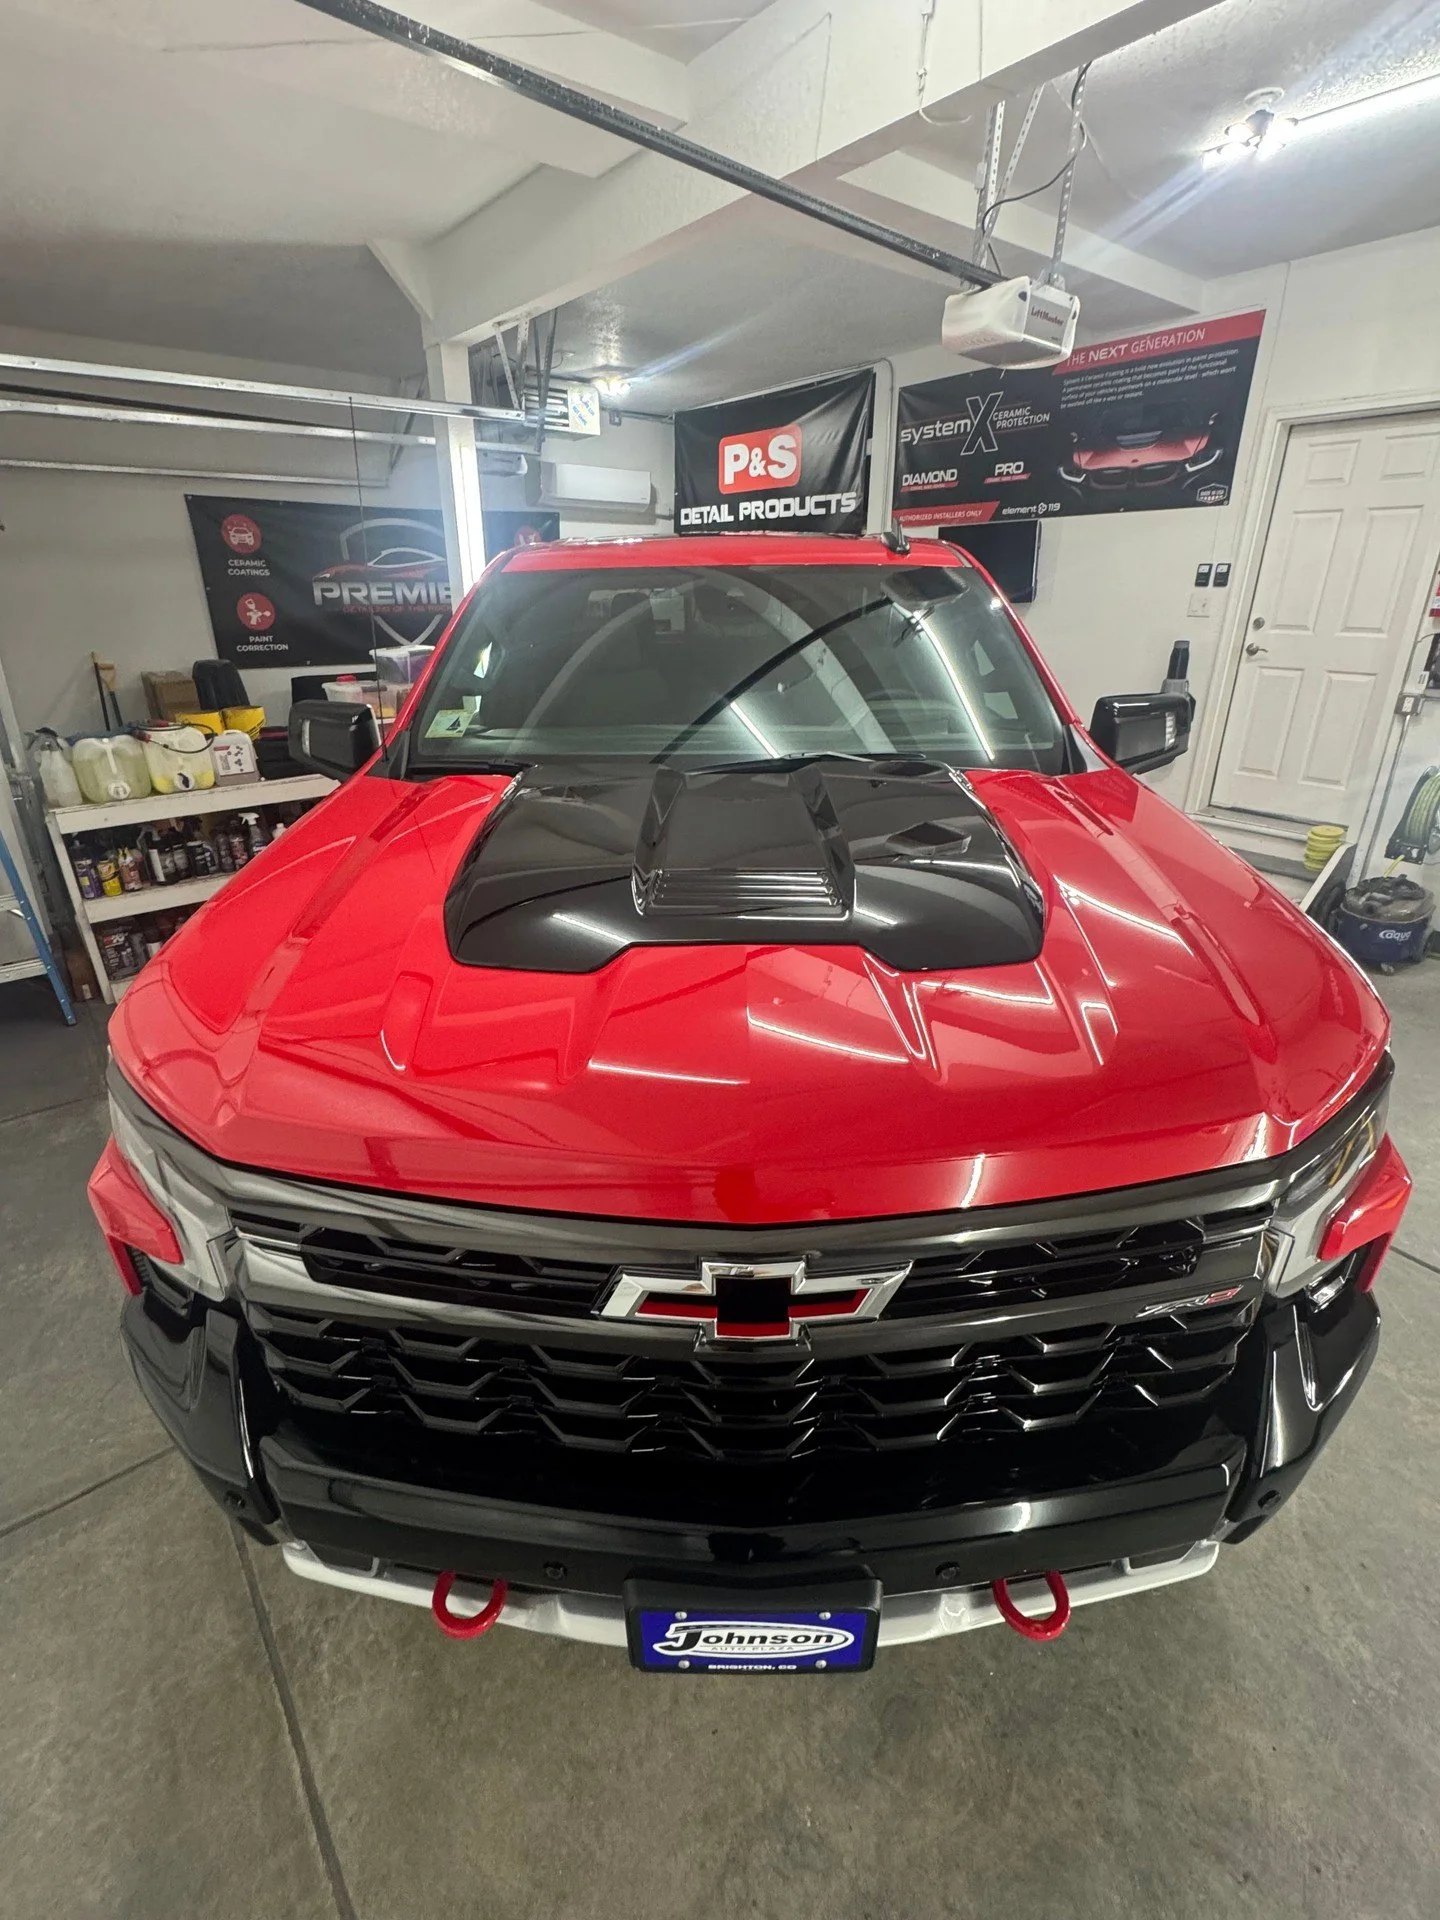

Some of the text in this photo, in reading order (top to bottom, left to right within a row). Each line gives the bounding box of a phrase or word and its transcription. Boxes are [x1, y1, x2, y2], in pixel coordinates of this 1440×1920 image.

[1031, 306, 1064, 326] LiftMaster
[1066, 328, 1206, 366] THE NEXT GENERATION
[992, 406, 1031, 421] CERAMIC
[996, 412, 1050, 430] PROTECTION
[901, 391, 1004, 456] system X
[723, 434, 797, 485] P&S
[902, 468, 958, 487] DIAMOND
[994, 461, 1024, 477] PRO
[680, 491, 857, 526] DETAIL PRODUCTS
[899, 509, 983, 522] AUTHORIZED INSTALLERS ONLY
[1002, 502, 1061, 516] element 119
[228, 559, 267, 567] CERAMIC
[228, 568, 271, 577] COATINGS
[236, 643, 289, 652] CORRECTION
[249, 635, 274, 643] PAINT
[1136, 1284, 1244, 1318] ZR2
[656, 1626, 835, 1652] Johnson
